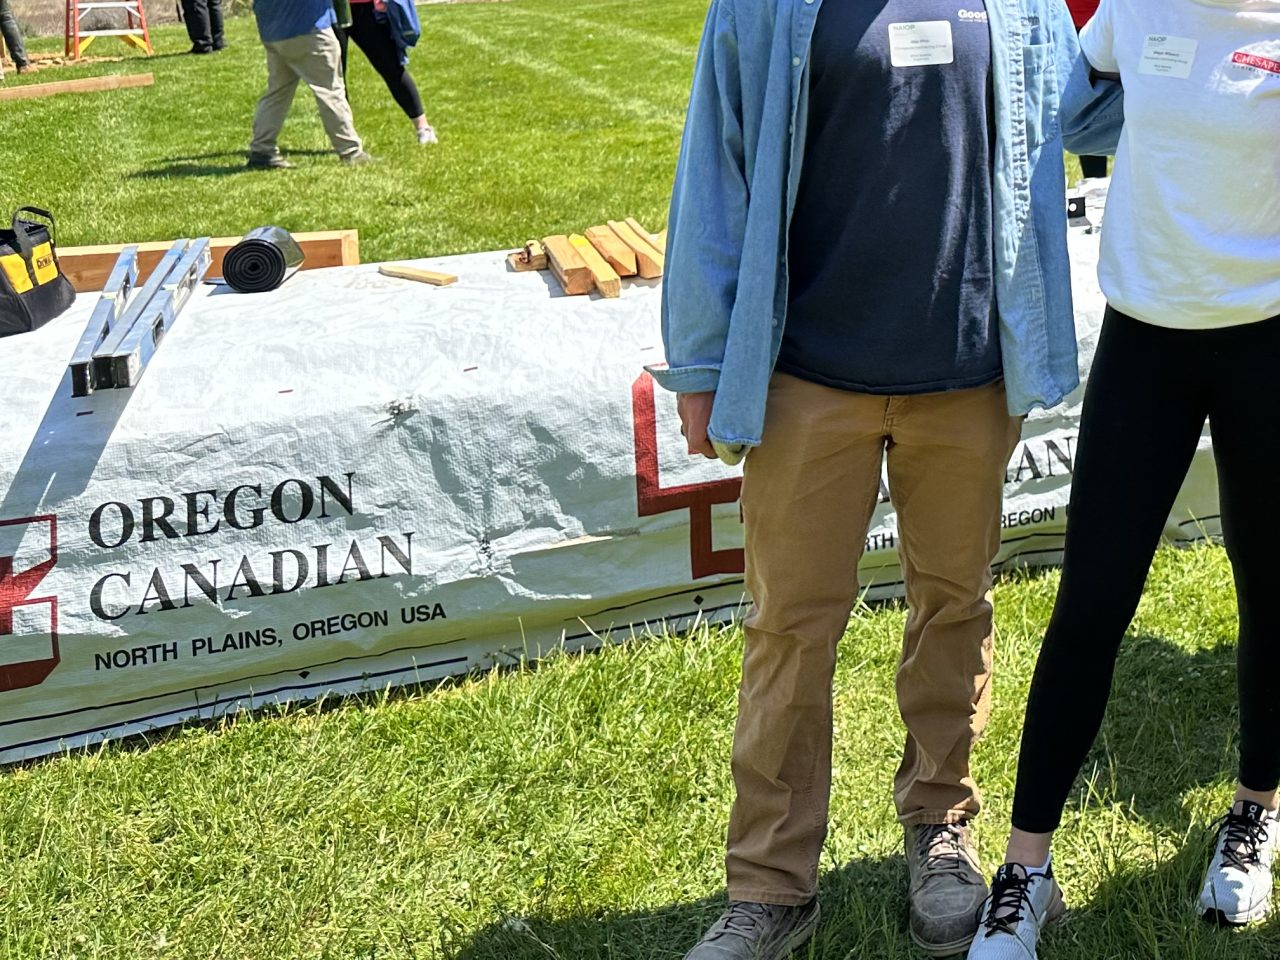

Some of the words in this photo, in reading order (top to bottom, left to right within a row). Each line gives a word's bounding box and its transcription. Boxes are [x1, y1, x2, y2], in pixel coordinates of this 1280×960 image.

[88, 472, 356, 549] OREGON
[90, 532, 415, 620] CANADIAN
[94, 641, 178, 671] NORTH
[192, 627, 283, 657] PLAINS,
[293, 610, 389, 641] OREGON
[401, 603, 447, 624] USA
